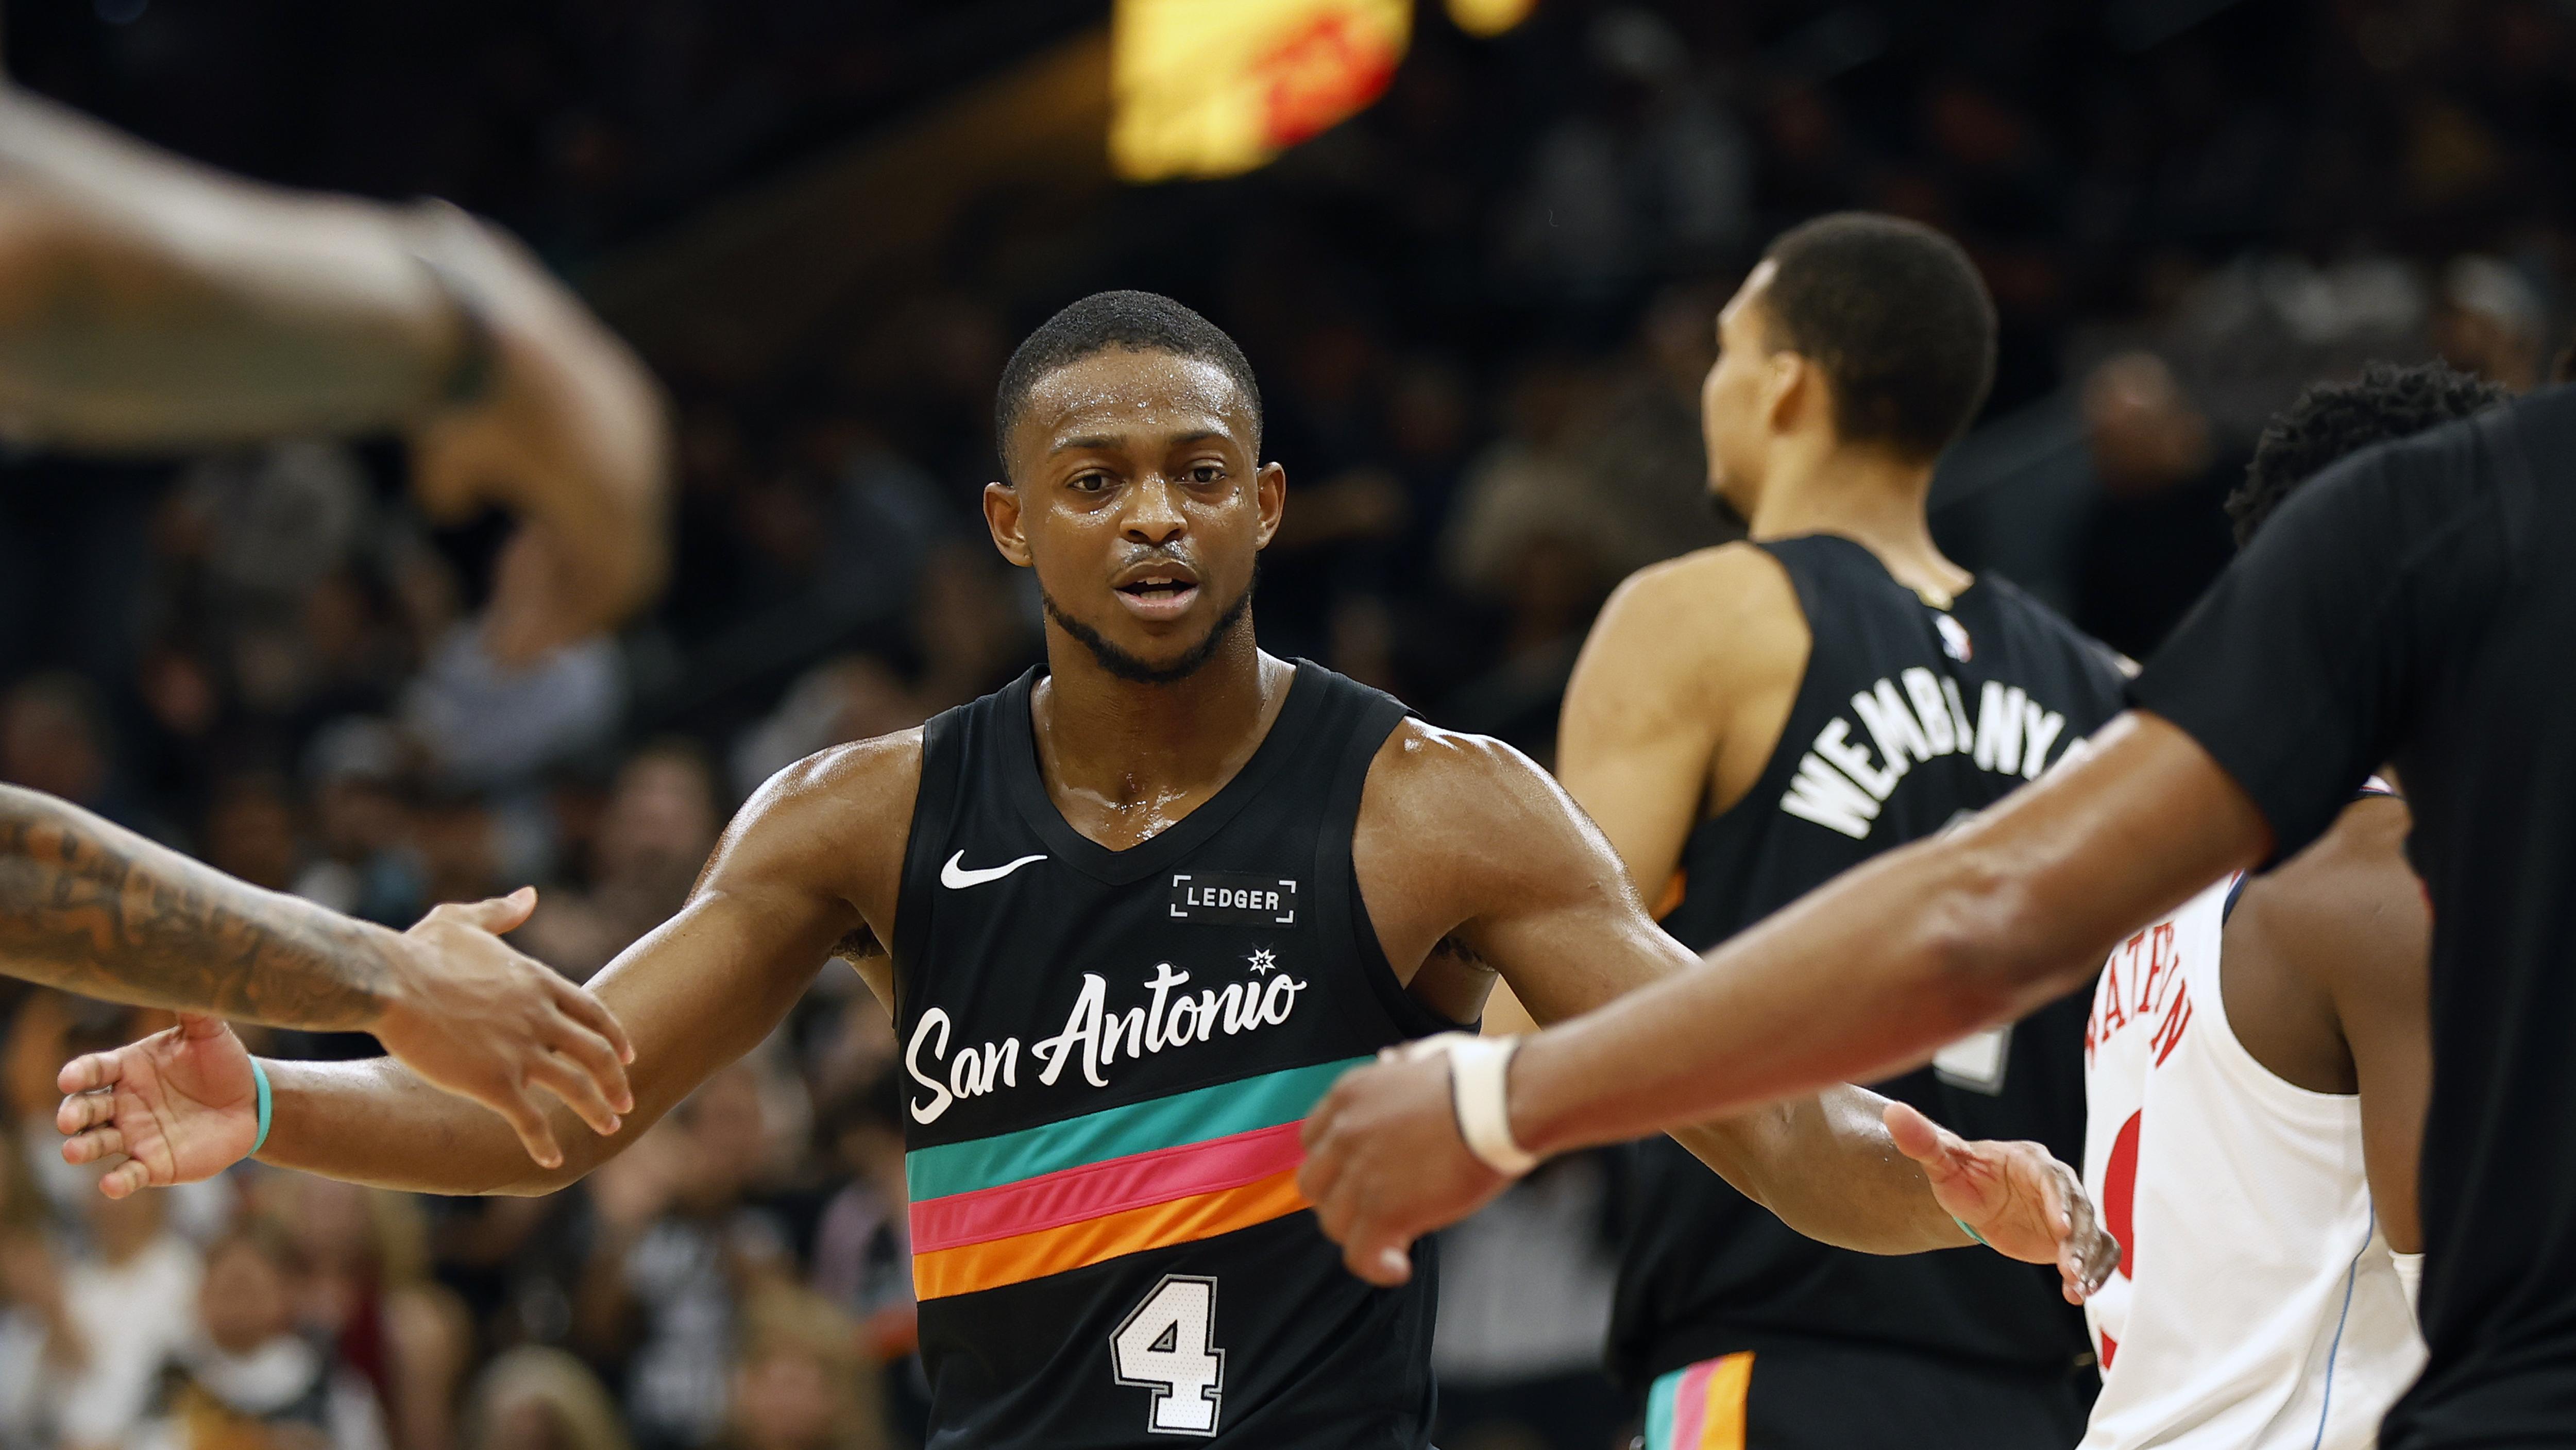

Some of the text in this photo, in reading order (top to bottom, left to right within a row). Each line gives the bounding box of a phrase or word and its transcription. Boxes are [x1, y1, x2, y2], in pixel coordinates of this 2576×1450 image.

[1187, 887, 1280, 911] LEDGER
[905, 948, 1307, 1125] San Antonio
[1109, 1273, 1226, 1438] 4
